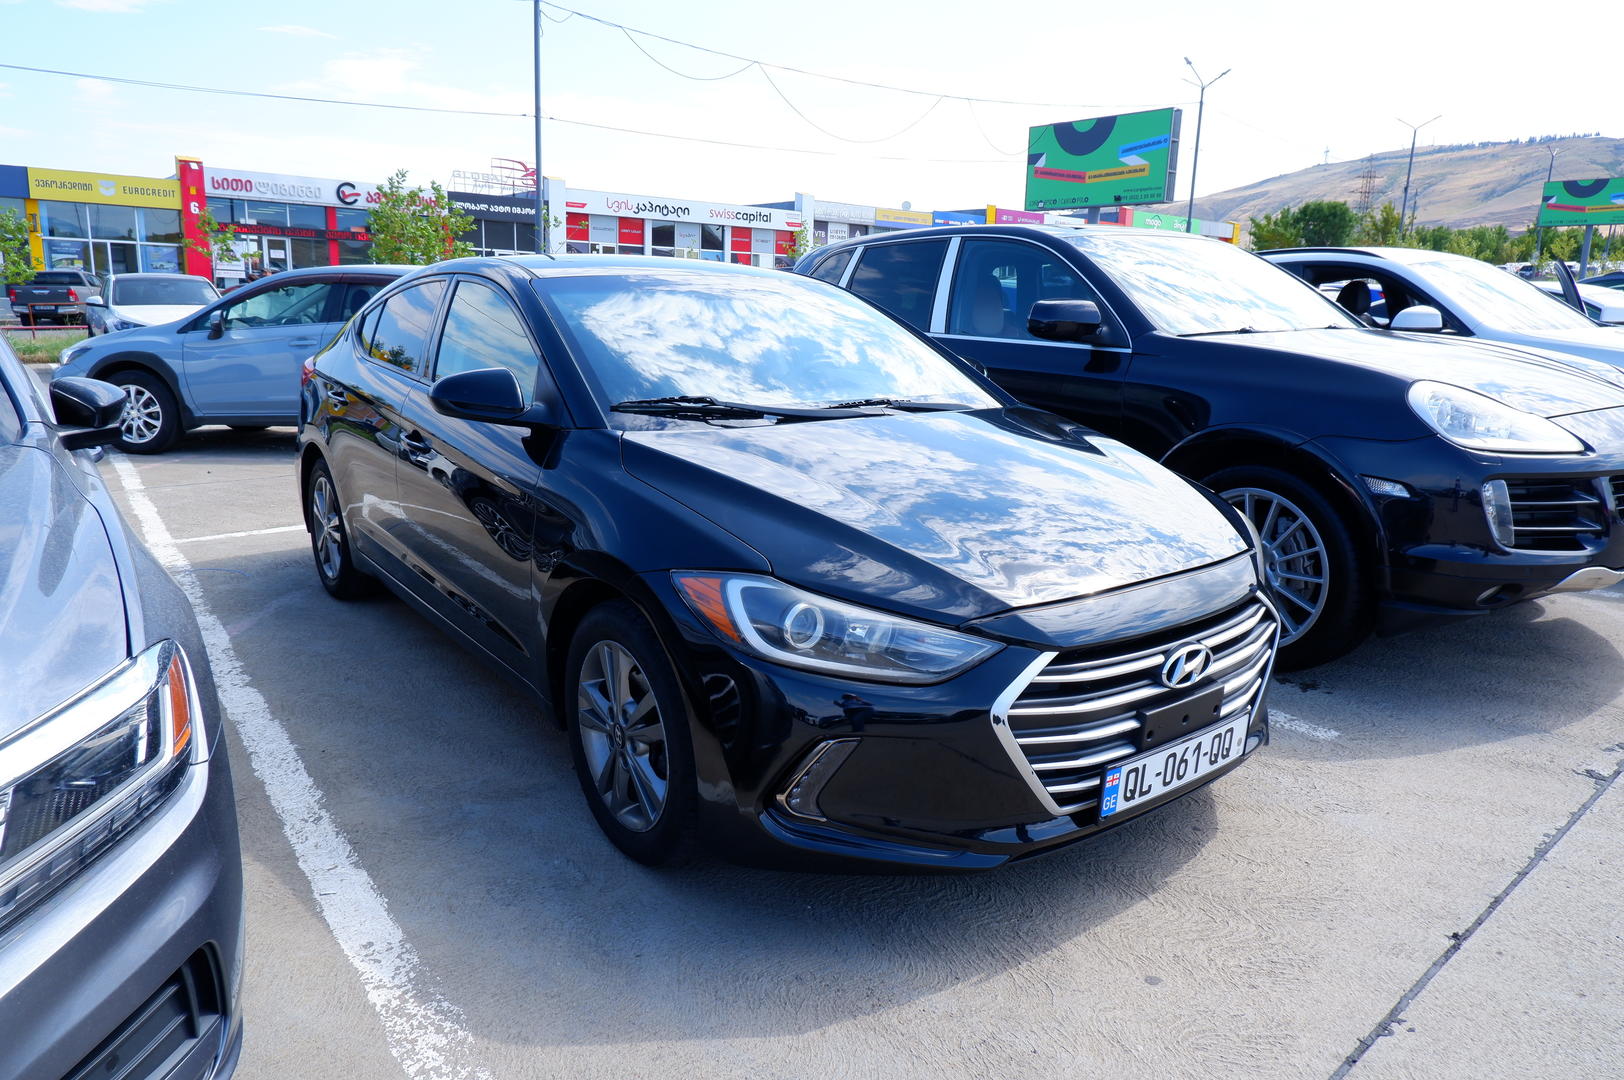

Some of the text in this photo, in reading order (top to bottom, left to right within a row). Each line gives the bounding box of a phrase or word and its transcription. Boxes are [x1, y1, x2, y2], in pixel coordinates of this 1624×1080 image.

[122, 185, 176, 198] EUROCREDIT
[190, 201, 200, 214] 6
[511, 206, 536, 216] იმპორ
[709, 208, 772, 224] swisscapital
[814, 230, 826, 238] VTB
[1123, 726, 1234, 803] QL-061-QQ
[1102, 794, 1117, 811] GE
